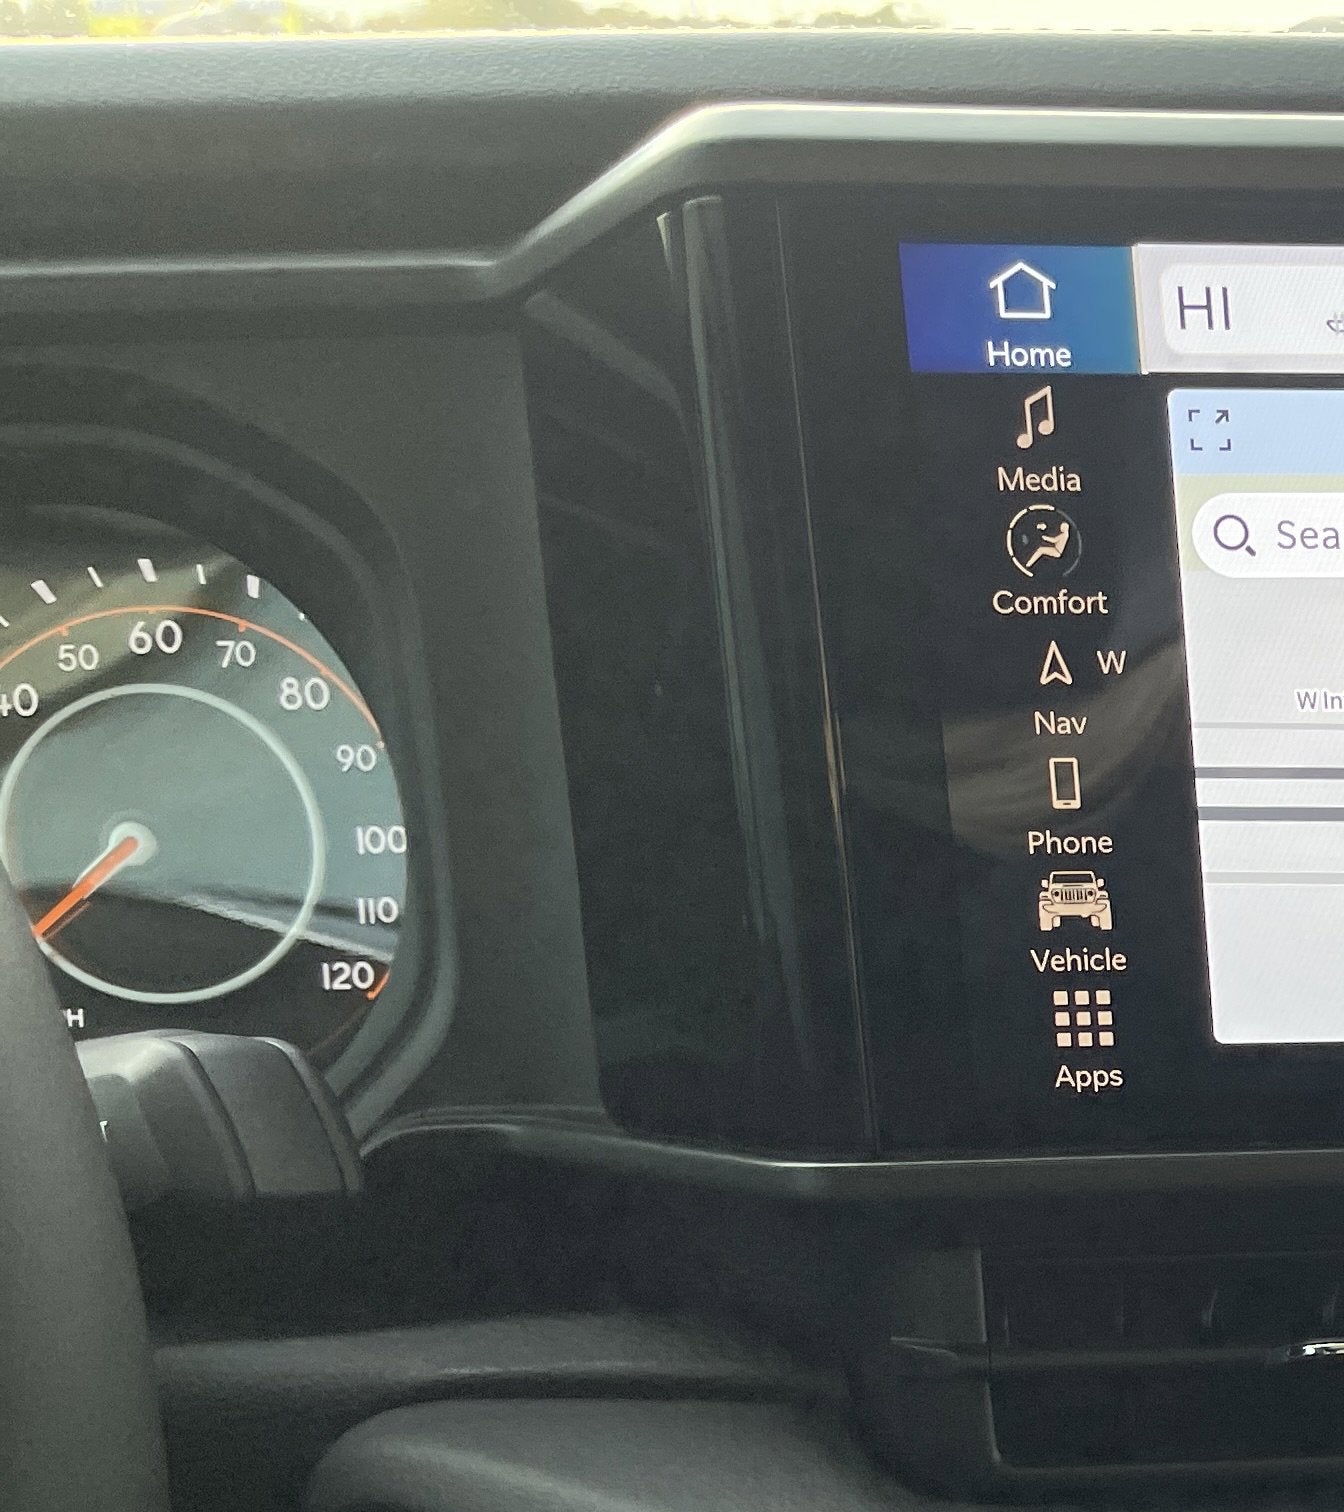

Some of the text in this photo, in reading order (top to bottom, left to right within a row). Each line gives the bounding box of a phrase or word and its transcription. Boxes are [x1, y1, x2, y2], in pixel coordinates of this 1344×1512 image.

[1178, 286, 1231, 331] HI
[987, 341, 1072, 368] Home
[997, 467, 1082, 492] Media
[992, 590, 1108, 616] Comfort
[128, 620, 183, 655] 60
[57, 644, 100, 672] 50
[215, 639, 257, 668] 70
[1096, 650, 1127, 675] W
[278, 676, 330, 711] 80
[1296, 691, 1318, 710] W
[1033, 711, 1088, 736] Nav
[336, 744, 377, 773] 90
[355, 825, 408, 855] 100
[1027, 831, 1114, 856] Phone
[357, 896, 399, 925] 110
[1030, 948, 1128, 973] Vehicle
[321, 961, 375, 991] 120
[1054, 1065, 1125, 1093] Apps
